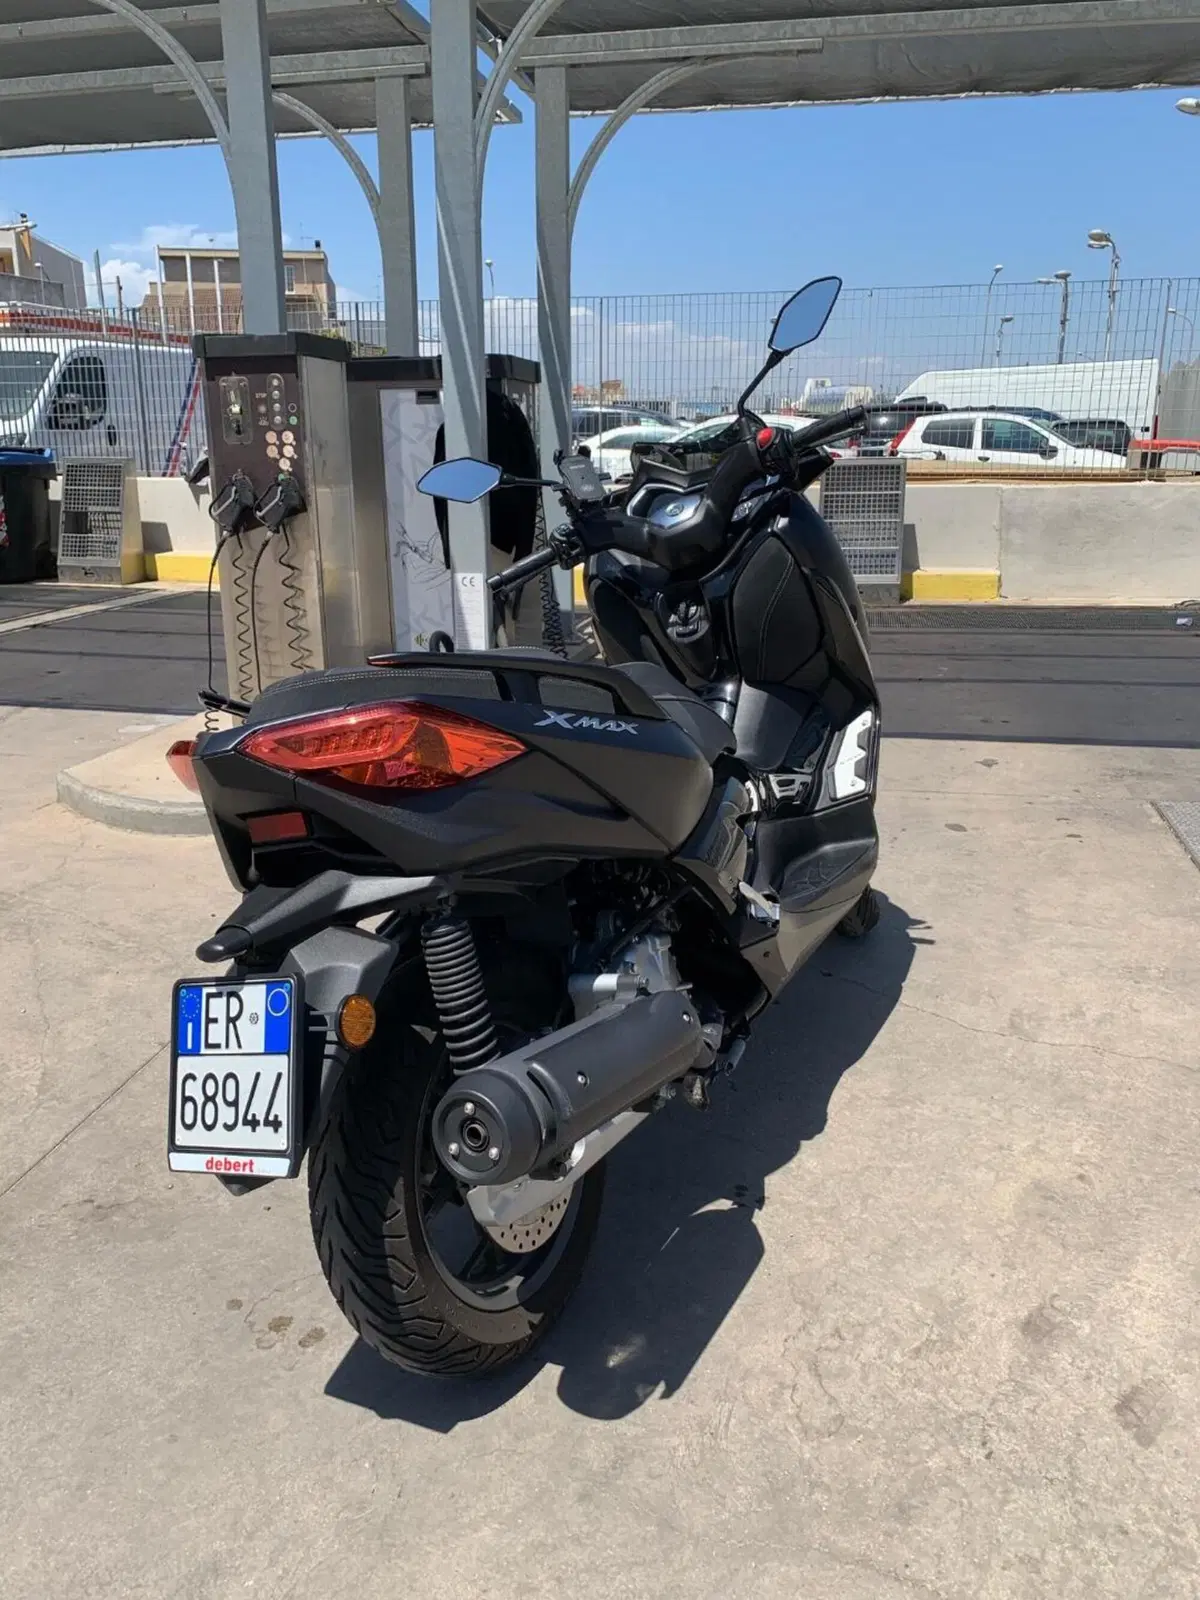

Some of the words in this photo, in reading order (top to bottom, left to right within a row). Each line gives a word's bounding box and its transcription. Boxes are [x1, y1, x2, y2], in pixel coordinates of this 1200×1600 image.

[461, 576, 476, 588] CE
[204, 990, 245, 1050] ER
[180, 1071, 284, 1134] 68944
[205, 1156, 254, 1173] debert
